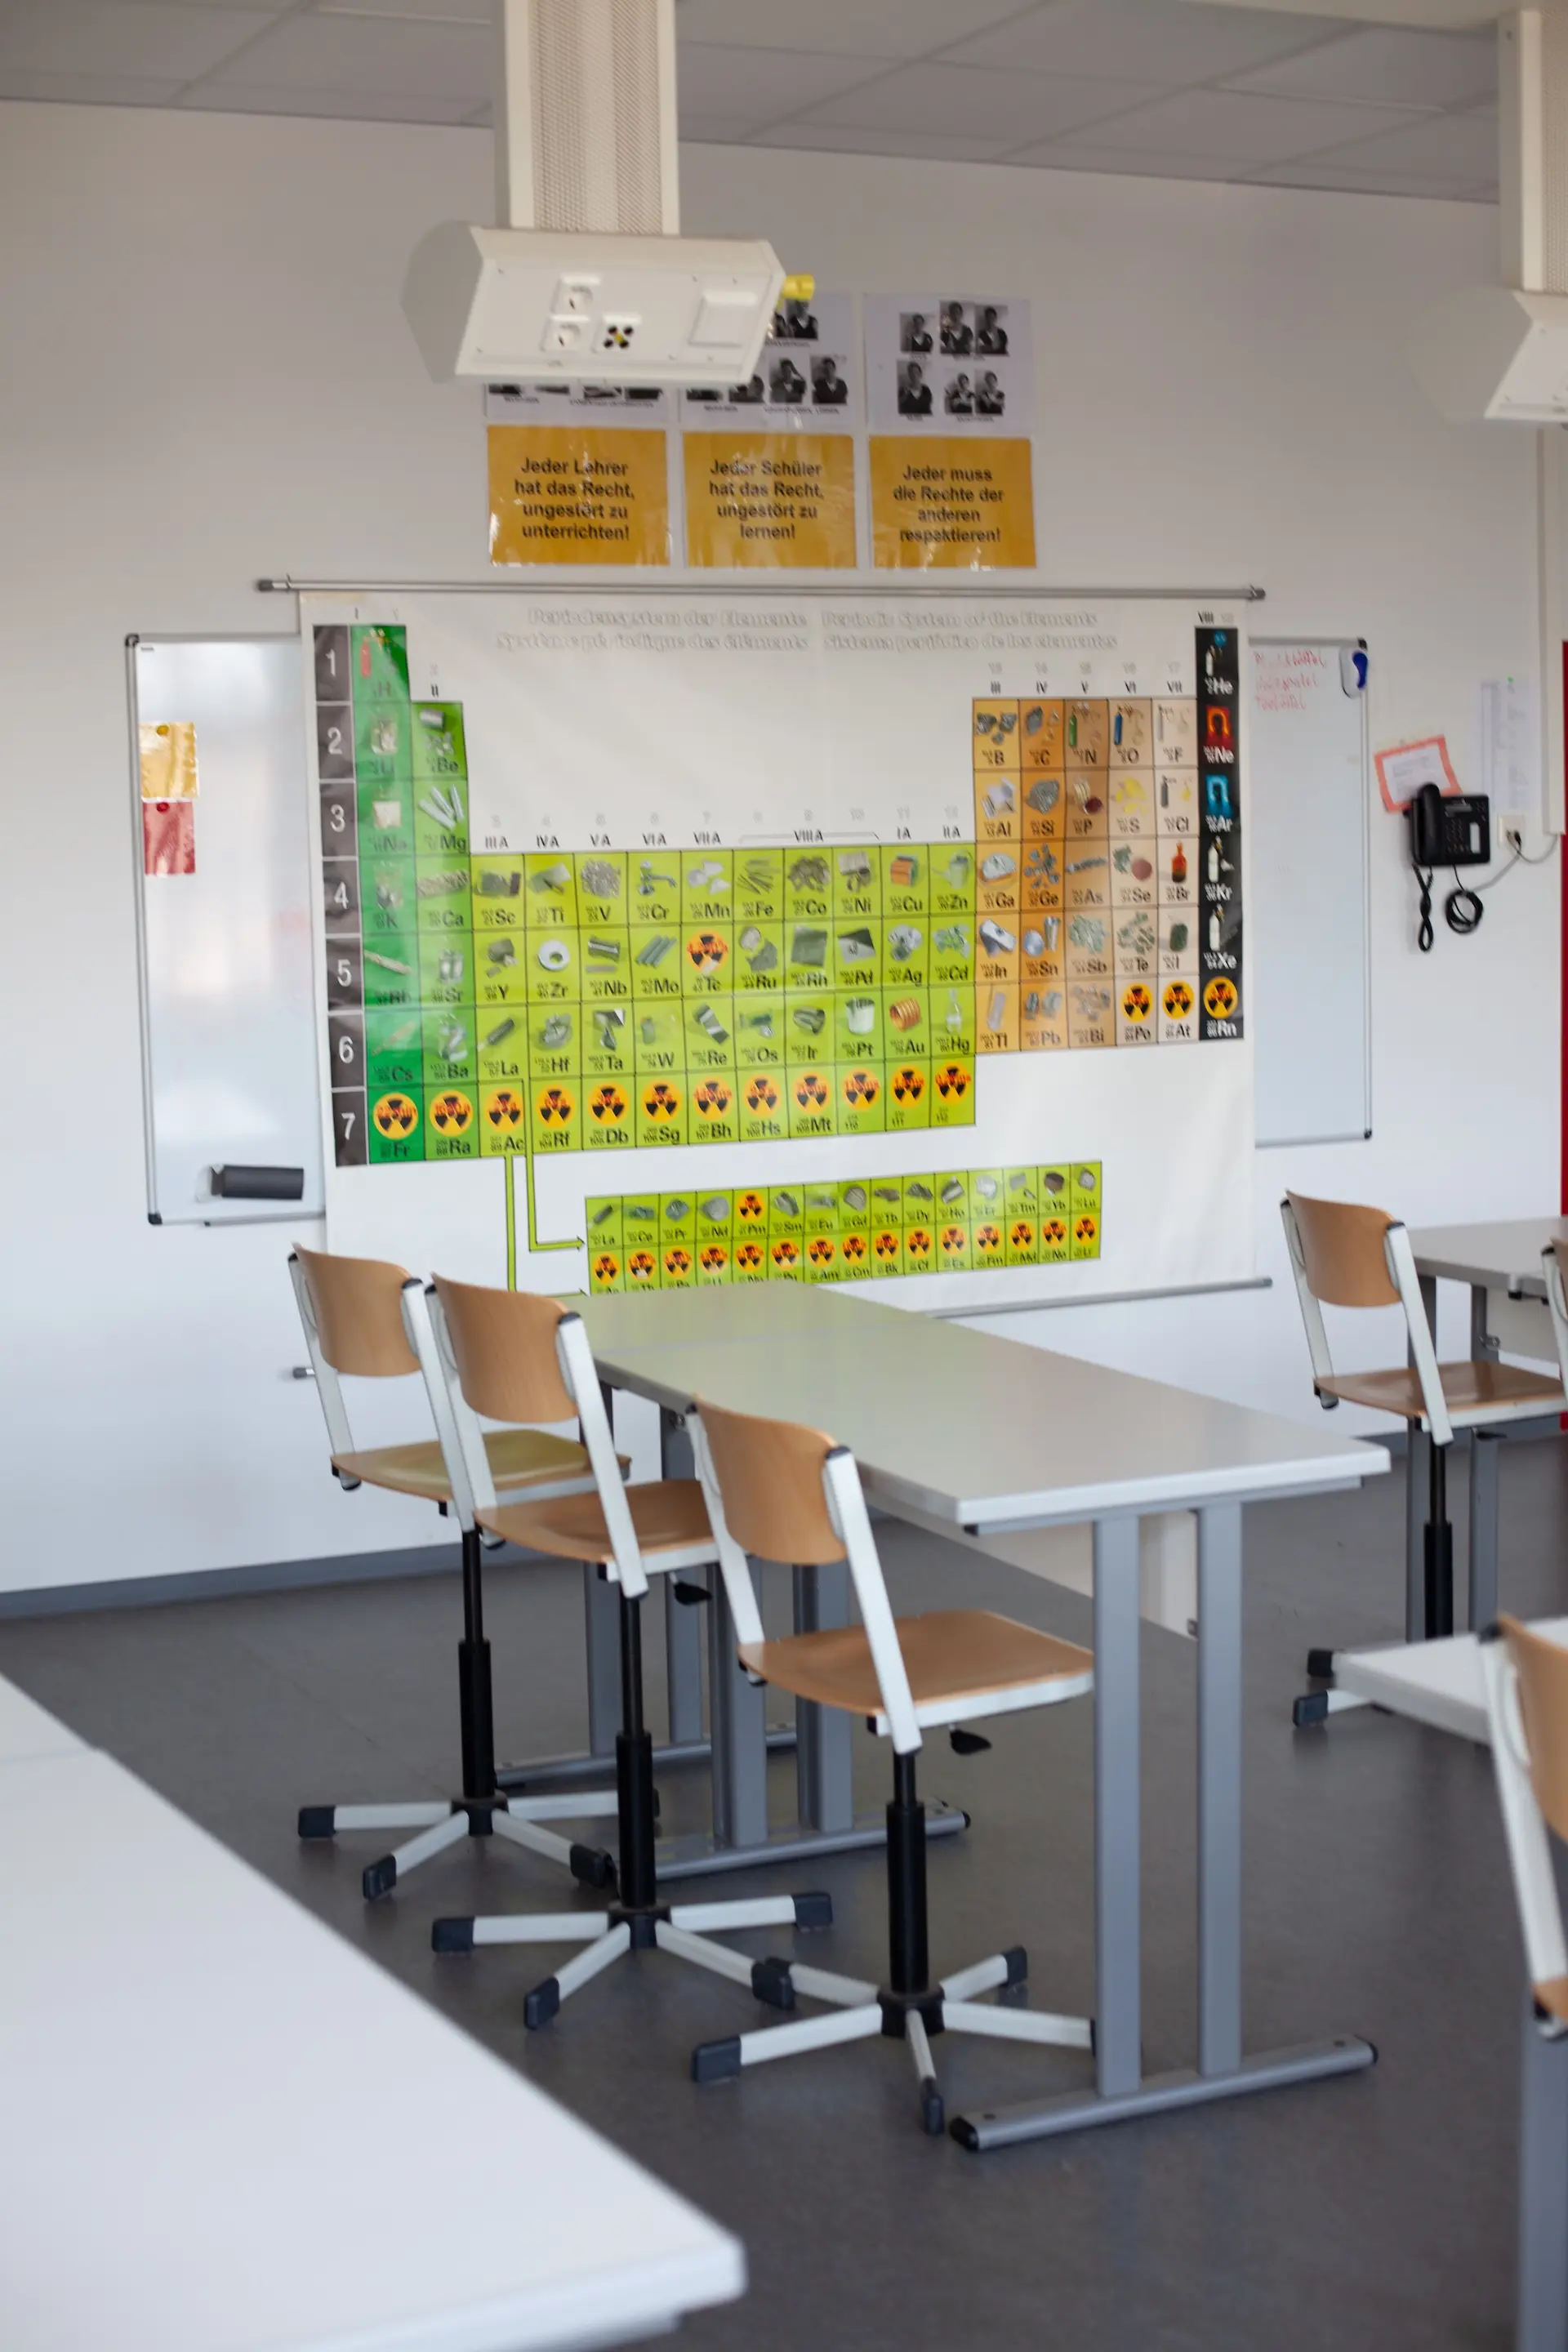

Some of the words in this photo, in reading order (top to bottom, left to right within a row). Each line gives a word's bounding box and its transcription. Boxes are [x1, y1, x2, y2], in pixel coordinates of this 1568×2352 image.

[521, 457, 568, 474] Jeder
[574, 458, 628, 476] Lehrer
[710, 459, 756, 475] Jeder
[761, 460, 822, 477] Schüler
[903, 464, 947, 481] Jeder
[950, 469, 992, 482] muss
[514, 479, 541, 496] hat
[546, 480, 577, 497] das
[581, 481, 635, 500] Recht,
[709, 480, 734, 497] hat
[740, 481, 768, 497] das
[893, 485, 915, 501] die
[921, 485, 974, 502] Rechte
[979, 487, 1004, 503] der
[522, 501, 604, 520] ungestört
[609, 506, 628, 519] zu
[717, 503, 795, 520] ungestört
[799, 506, 817, 519] zu
[918, 507, 981, 522] anderen
[522, 523, 630, 541] unterrichten!
[740, 523, 795, 540] lernen!
[900, 527, 1001, 545] respektieren!
[326, 648, 336, 677] 1
[327, 727, 343, 755] 2
[330, 804, 345, 833] 3
[333, 881, 349, 910] 4
[336, 959, 352, 987] 5
[338, 1036, 354, 1063] 6
[341, 1112, 355, 1140] 7
